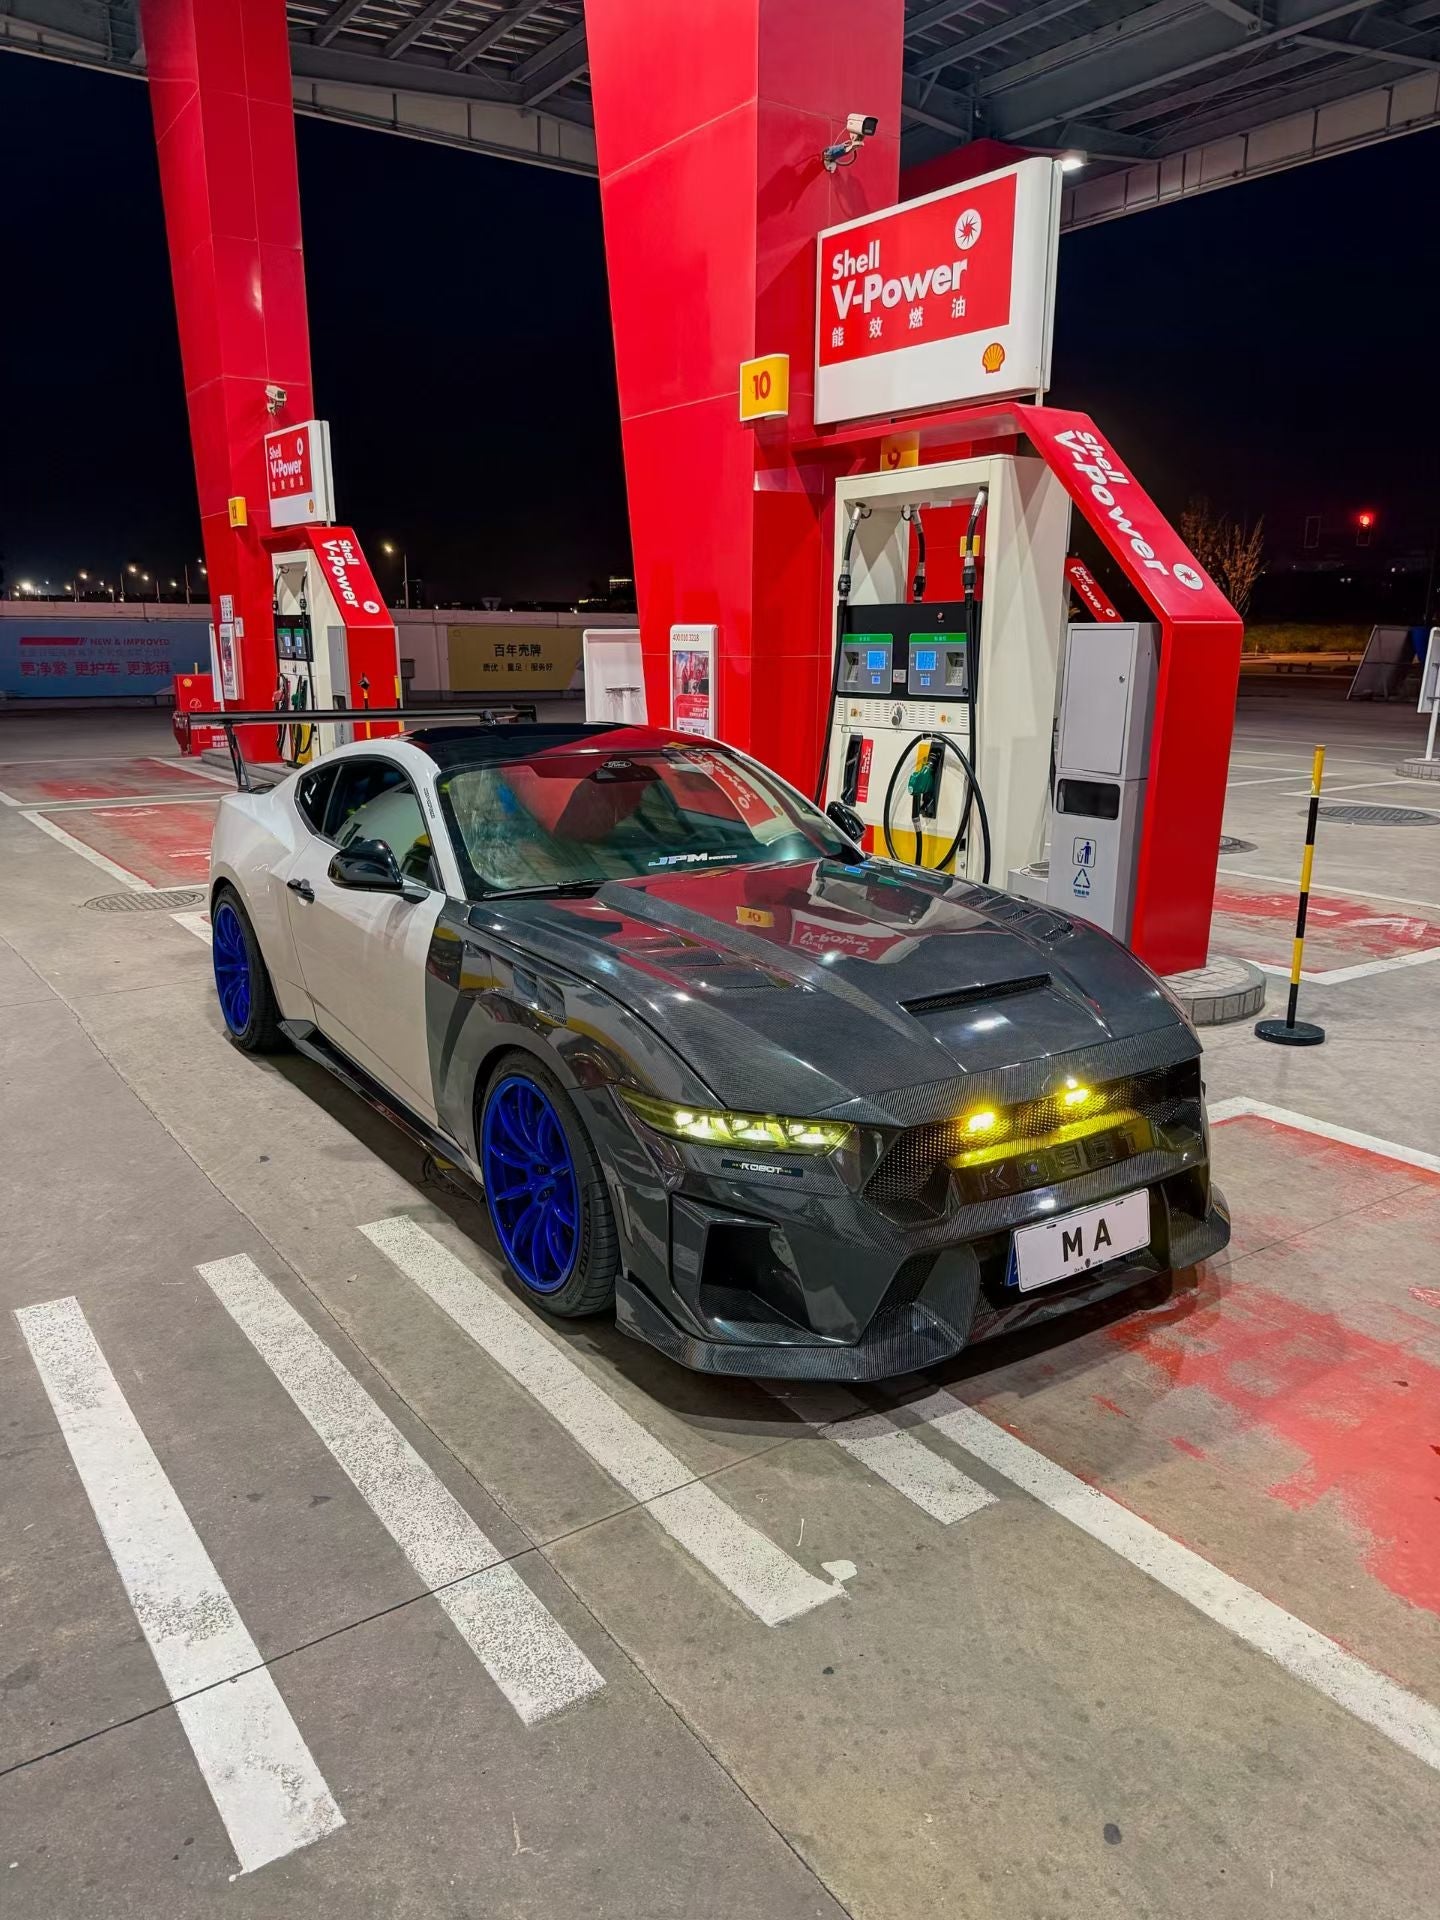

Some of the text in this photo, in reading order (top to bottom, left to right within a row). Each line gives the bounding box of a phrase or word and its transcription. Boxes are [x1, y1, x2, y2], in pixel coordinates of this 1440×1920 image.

[831, 239, 881, 281] Shell
[831, 258, 968, 320] V-Power
[831, 296, 966, 348] 能效燃油
[752, 370, 772, 401] 10
[269, 443, 282, 460] Shell
[1076, 430, 1130, 485] Shell
[270, 459, 302, 479] V-Power
[1054, 430, 1169, 576] V-Power
[338, 539, 360, 566] Shell
[321, 540, 360, 608] V-Power
[90, 638, 112, 646] NEW
[123, 638, 170, 646] IMPROVED
[493, 643, 542, 657] 百年壳牌
[647, 852, 708, 867] JPM
[741, 1162, 782, 1174] ROBOT
[1062, 1218, 1112, 1263] M A
